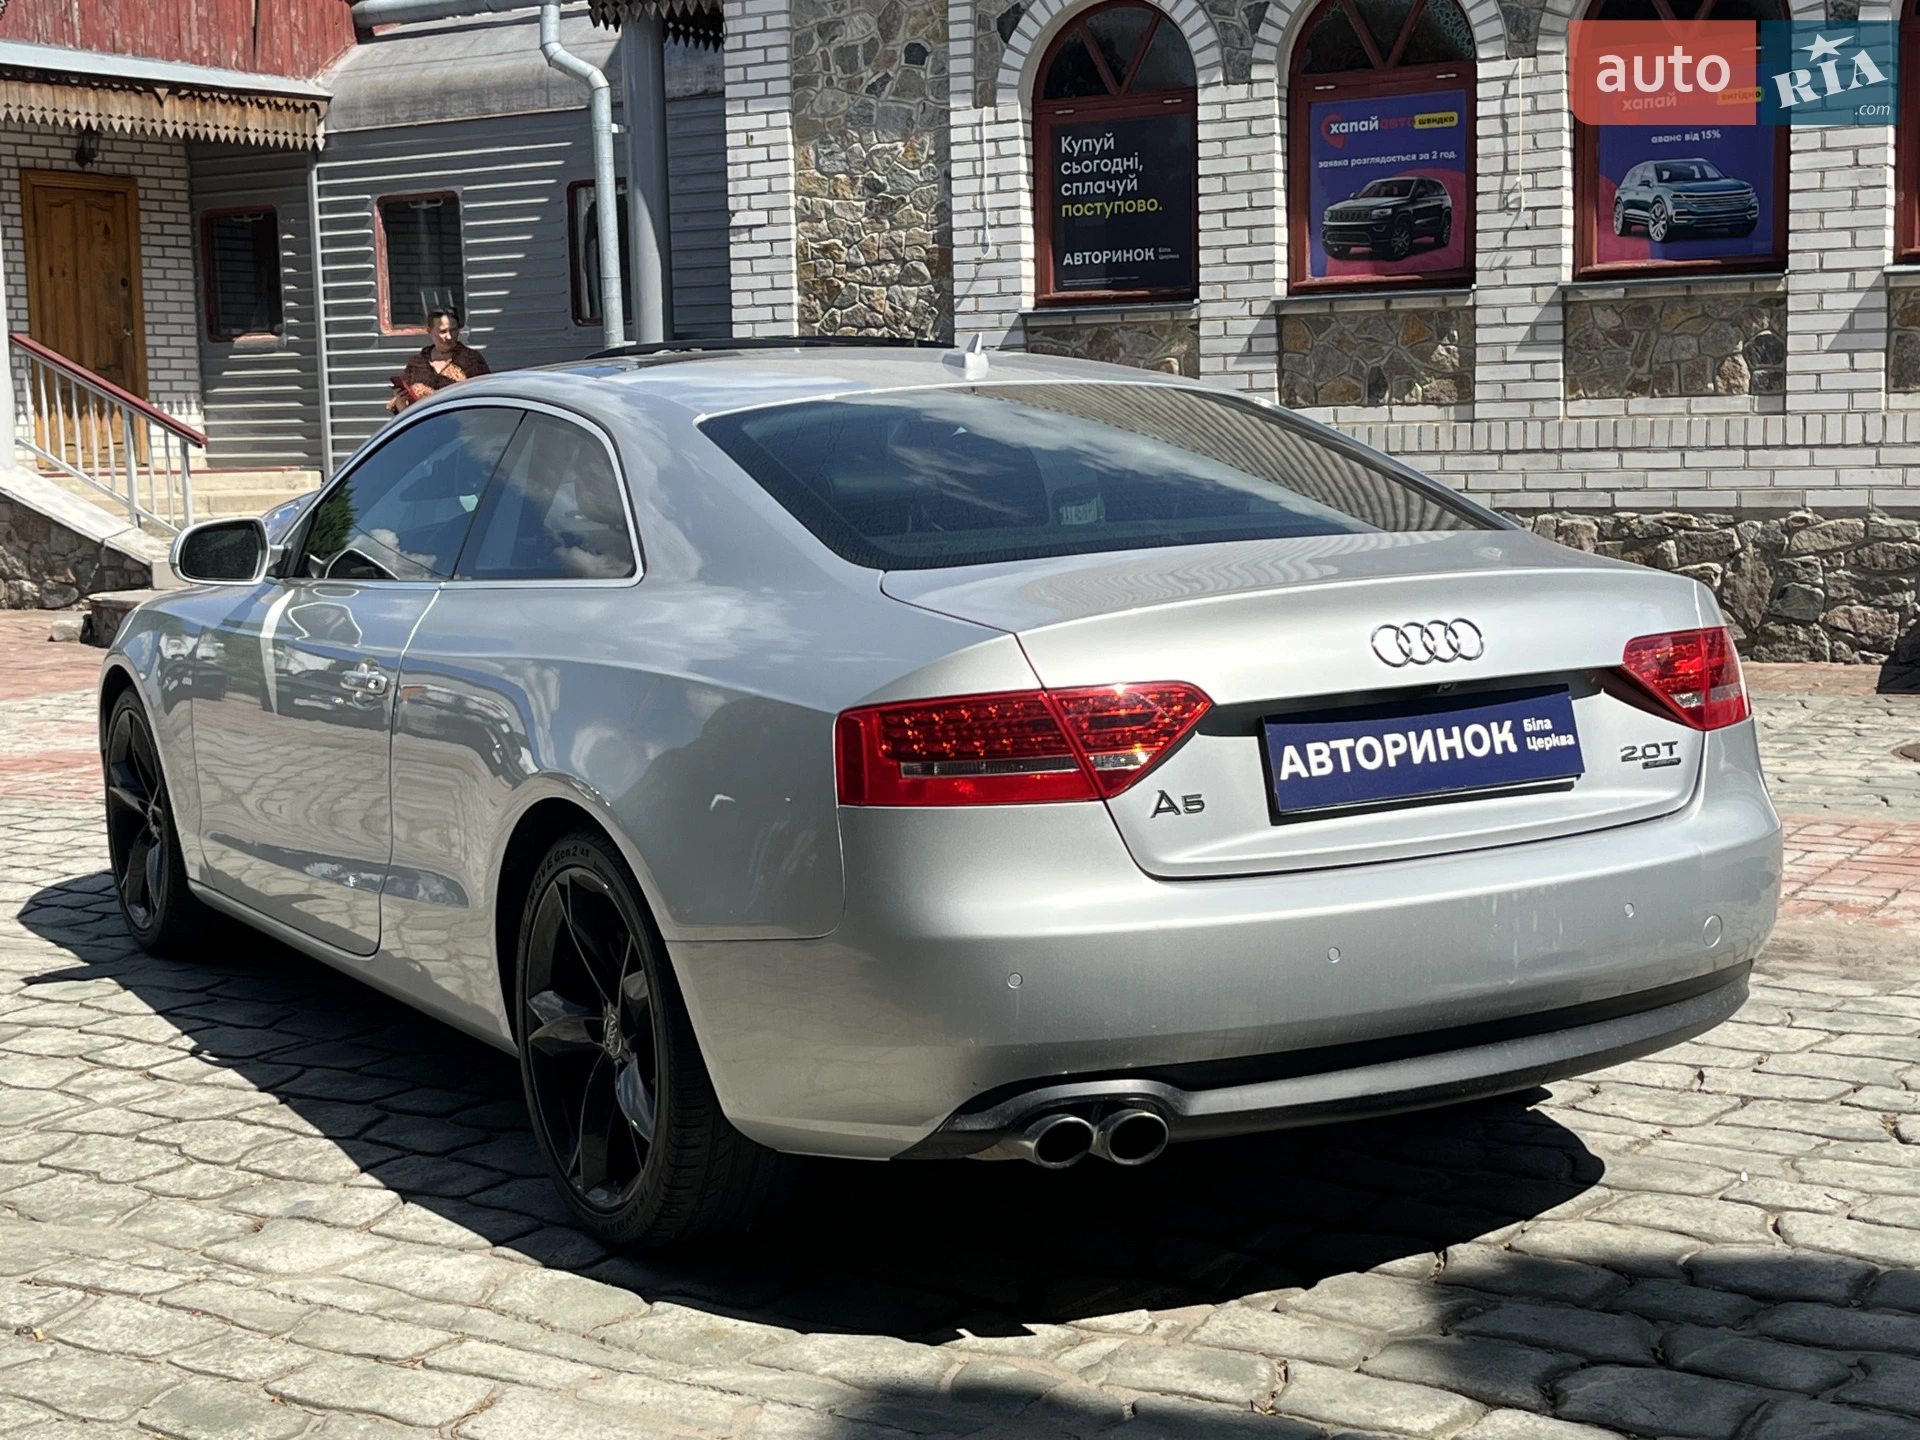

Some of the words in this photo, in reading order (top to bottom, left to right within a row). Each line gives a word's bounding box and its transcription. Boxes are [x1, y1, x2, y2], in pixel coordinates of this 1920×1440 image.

[1418, 115, 1455, 125] швидко
[1060, 132, 1115, 157] Купуй
[1651, 134, 1682, 144] аванс
[1684, 131, 1700, 142] від
[1700, 129, 1721, 140] 15%
[1060, 152, 1144, 175] сьогодні,
[1318, 158, 1348, 168] заявка
[1351, 153, 1416, 167] розглядається
[1418, 152, 1429, 160] за
[1431, 150, 1437, 160] 2
[1439, 150, 1457, 160] год.
[1060, 173, 1138, 197] сплачуй
[1061, 198, 1163, 219] поступово.
[1062, 247, 1155, 266] АВТОРИНОК
[1522, 717, 1553, 732] Біла
[1279, 720, 1518, 780] АВТОРИНОК
[1526, 733, 1575, 751] Церква
[1620, 740, 1678, 763] 2.0T
[1150, 789, 1205, 818] A5
